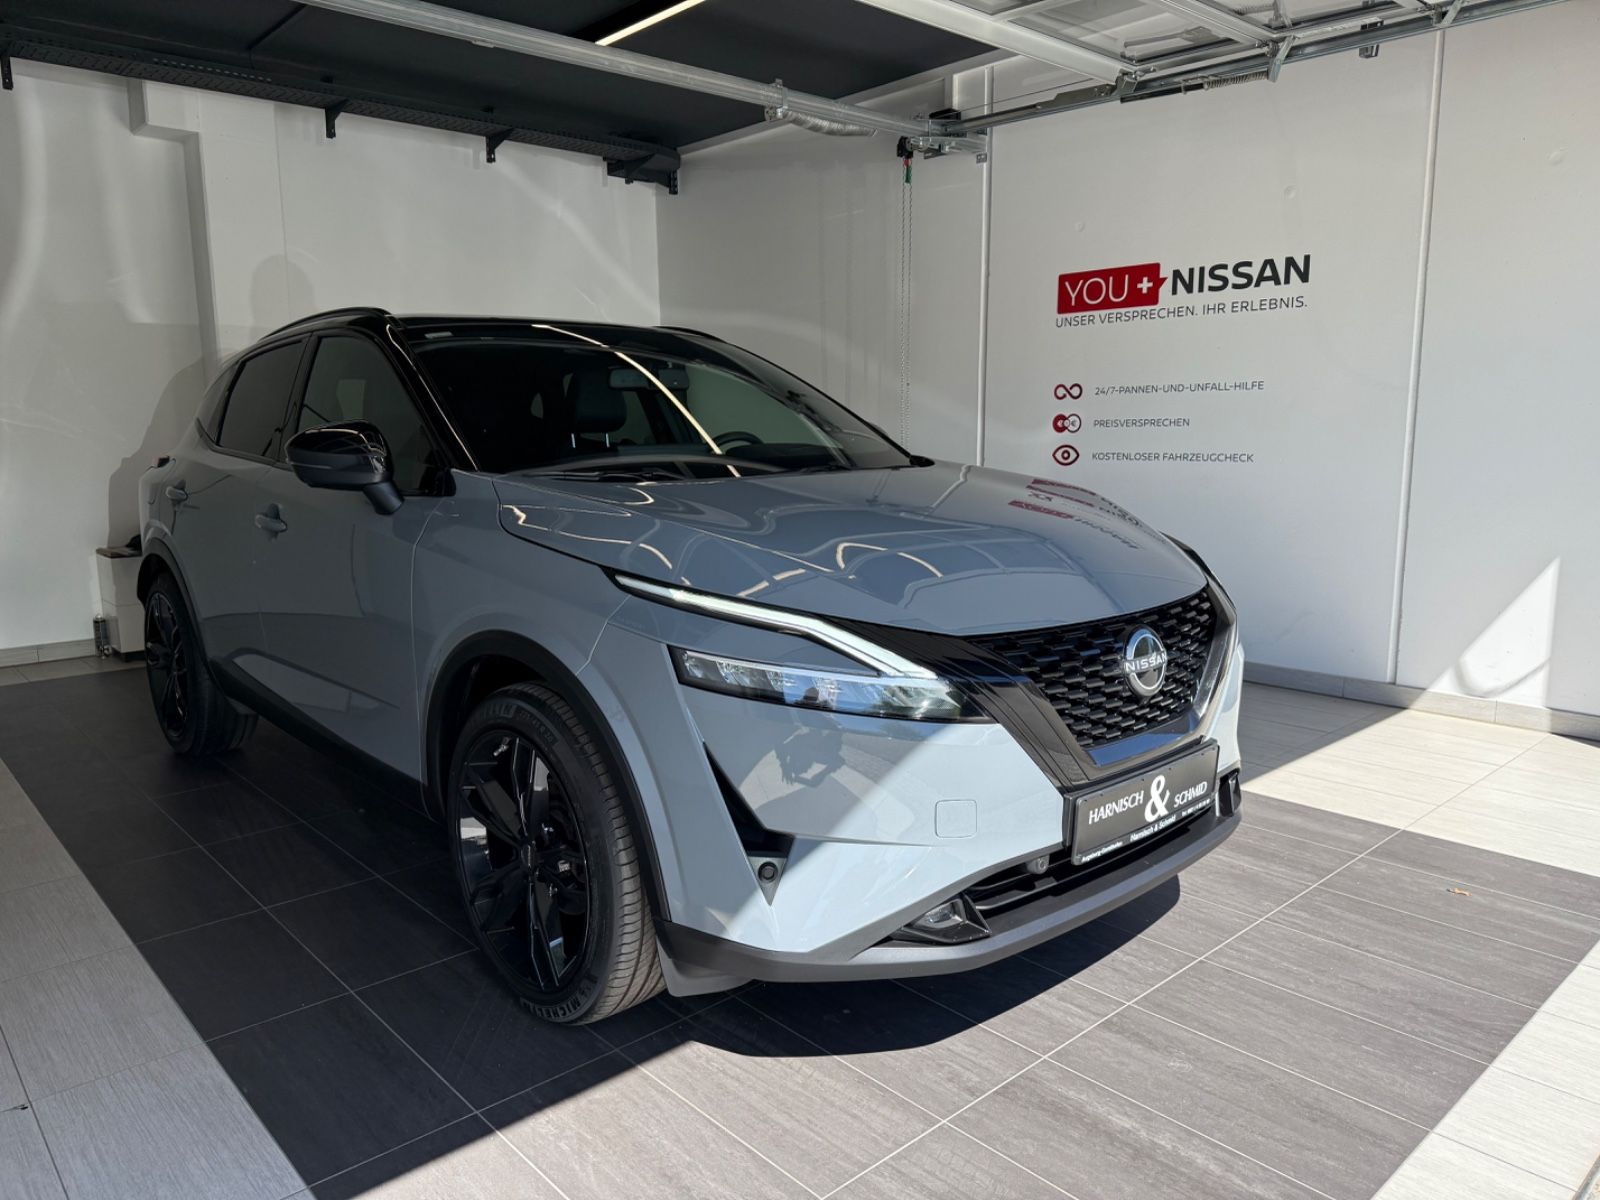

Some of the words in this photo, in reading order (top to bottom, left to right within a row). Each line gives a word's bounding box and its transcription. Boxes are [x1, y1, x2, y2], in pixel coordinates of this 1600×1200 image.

[1064, 274, 1129, 306] YOU
[1171, 254, 1311, 296] NISSAN
[1055, 315, 1095, 328] UNSER
[1098, 305, 1198, 324] VERSPRECHEN.
[1202, 302, 1226, 316] IHR
[1230, 295, 1308, 313] ERLEBNIS.
[1094, 380, 1265, 396] 24/7-PANNEN-UND-UNFALL-HILFE
[1093, 418, 1190, 428] PREISVERSPRECHEN
[1091, 452, 1160, 462] KOSTENLOSER
[1162, 453, 1254, 463] FAHRZEUGCHECK
[1125, 652, 1167, 671] NISSAN
[1088, 790, 1144, 825] HARNISCH
[1144, 775, 1170, 823] &
[1173, 781, 1208, 808] SCHMID
